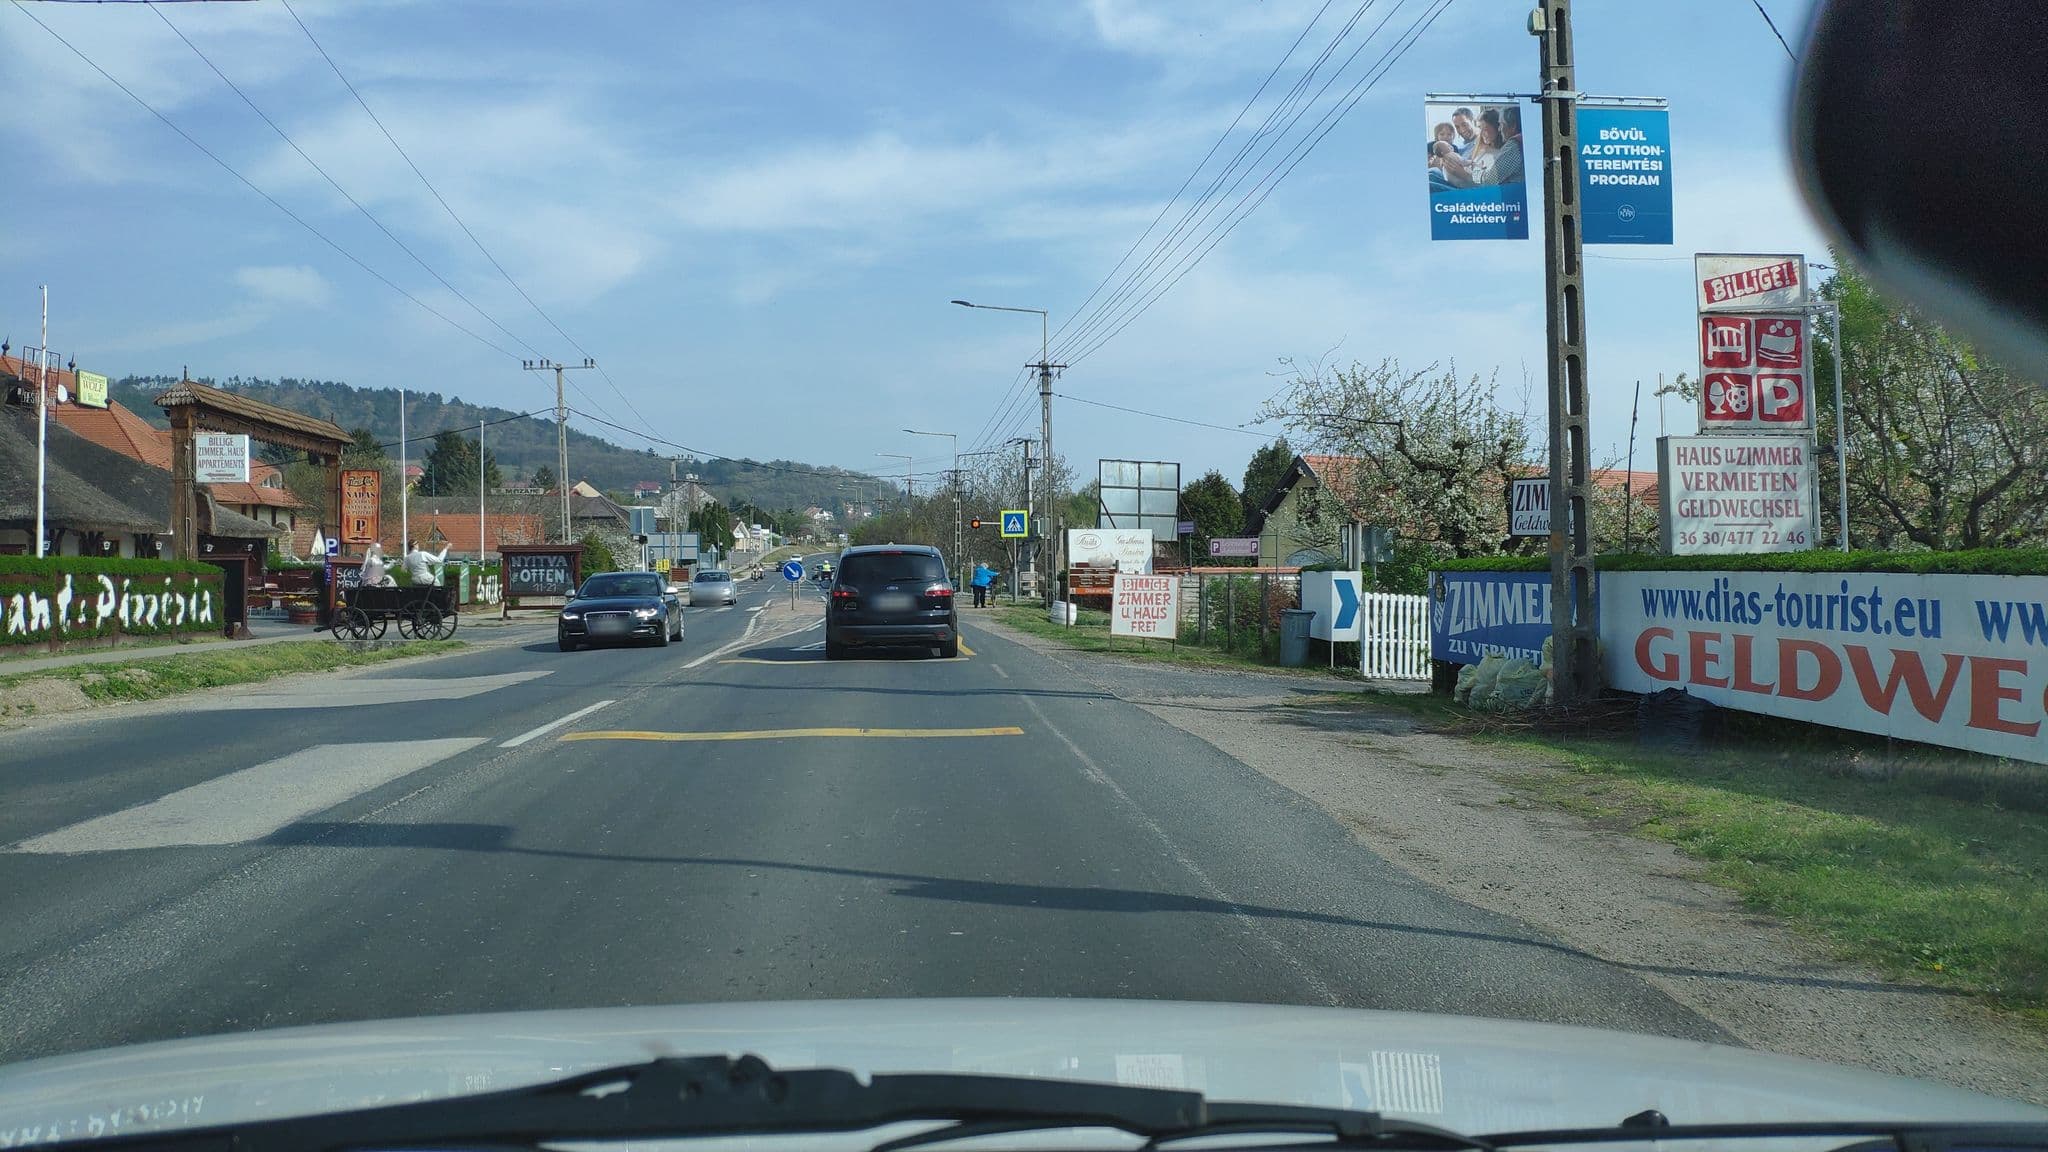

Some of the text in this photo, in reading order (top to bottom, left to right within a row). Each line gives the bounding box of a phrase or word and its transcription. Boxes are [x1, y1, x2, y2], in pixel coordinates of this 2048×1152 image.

[1600, 127, 1647, 141] BŐVÜL
[1582, 145, 1665, 156] AZ OTTHON-
[1585, 158, 1663, 171] TEREMTÉSI
[1589, 174, 1660, 186] PROGRAM
[1434, 201, 1521, 213] Családvédelmi
[1450, 212, 1507, 224] Akcióterv
[83, 380, 105, 393] WOLF
[208, 437, 234, 447] BILLIGE
[198, 446, 245, 457] ZIMMER HAUS
[1676, 446, 1722, 466] HAUS
[1736, 446, 1803, 466] ZIMMER
[1681, 472, 1798, 492] VERMIETEN
[1678, 498, 1804, 518] GELDWECHSEL
[1680, 530, 1805, 547] 36 30/477 22 46
[511, 555, 568, 567] NYITVA
[1121, 578, 1170, 592] BILLIGE
[1133, 607, 1167, 620] HAUS
[1641, 577, 1943, 639] www.dias-tourist.eu
[1448, 638, 1467, 654] ZU
[1634, 626, 2048, 738] GELDWE
